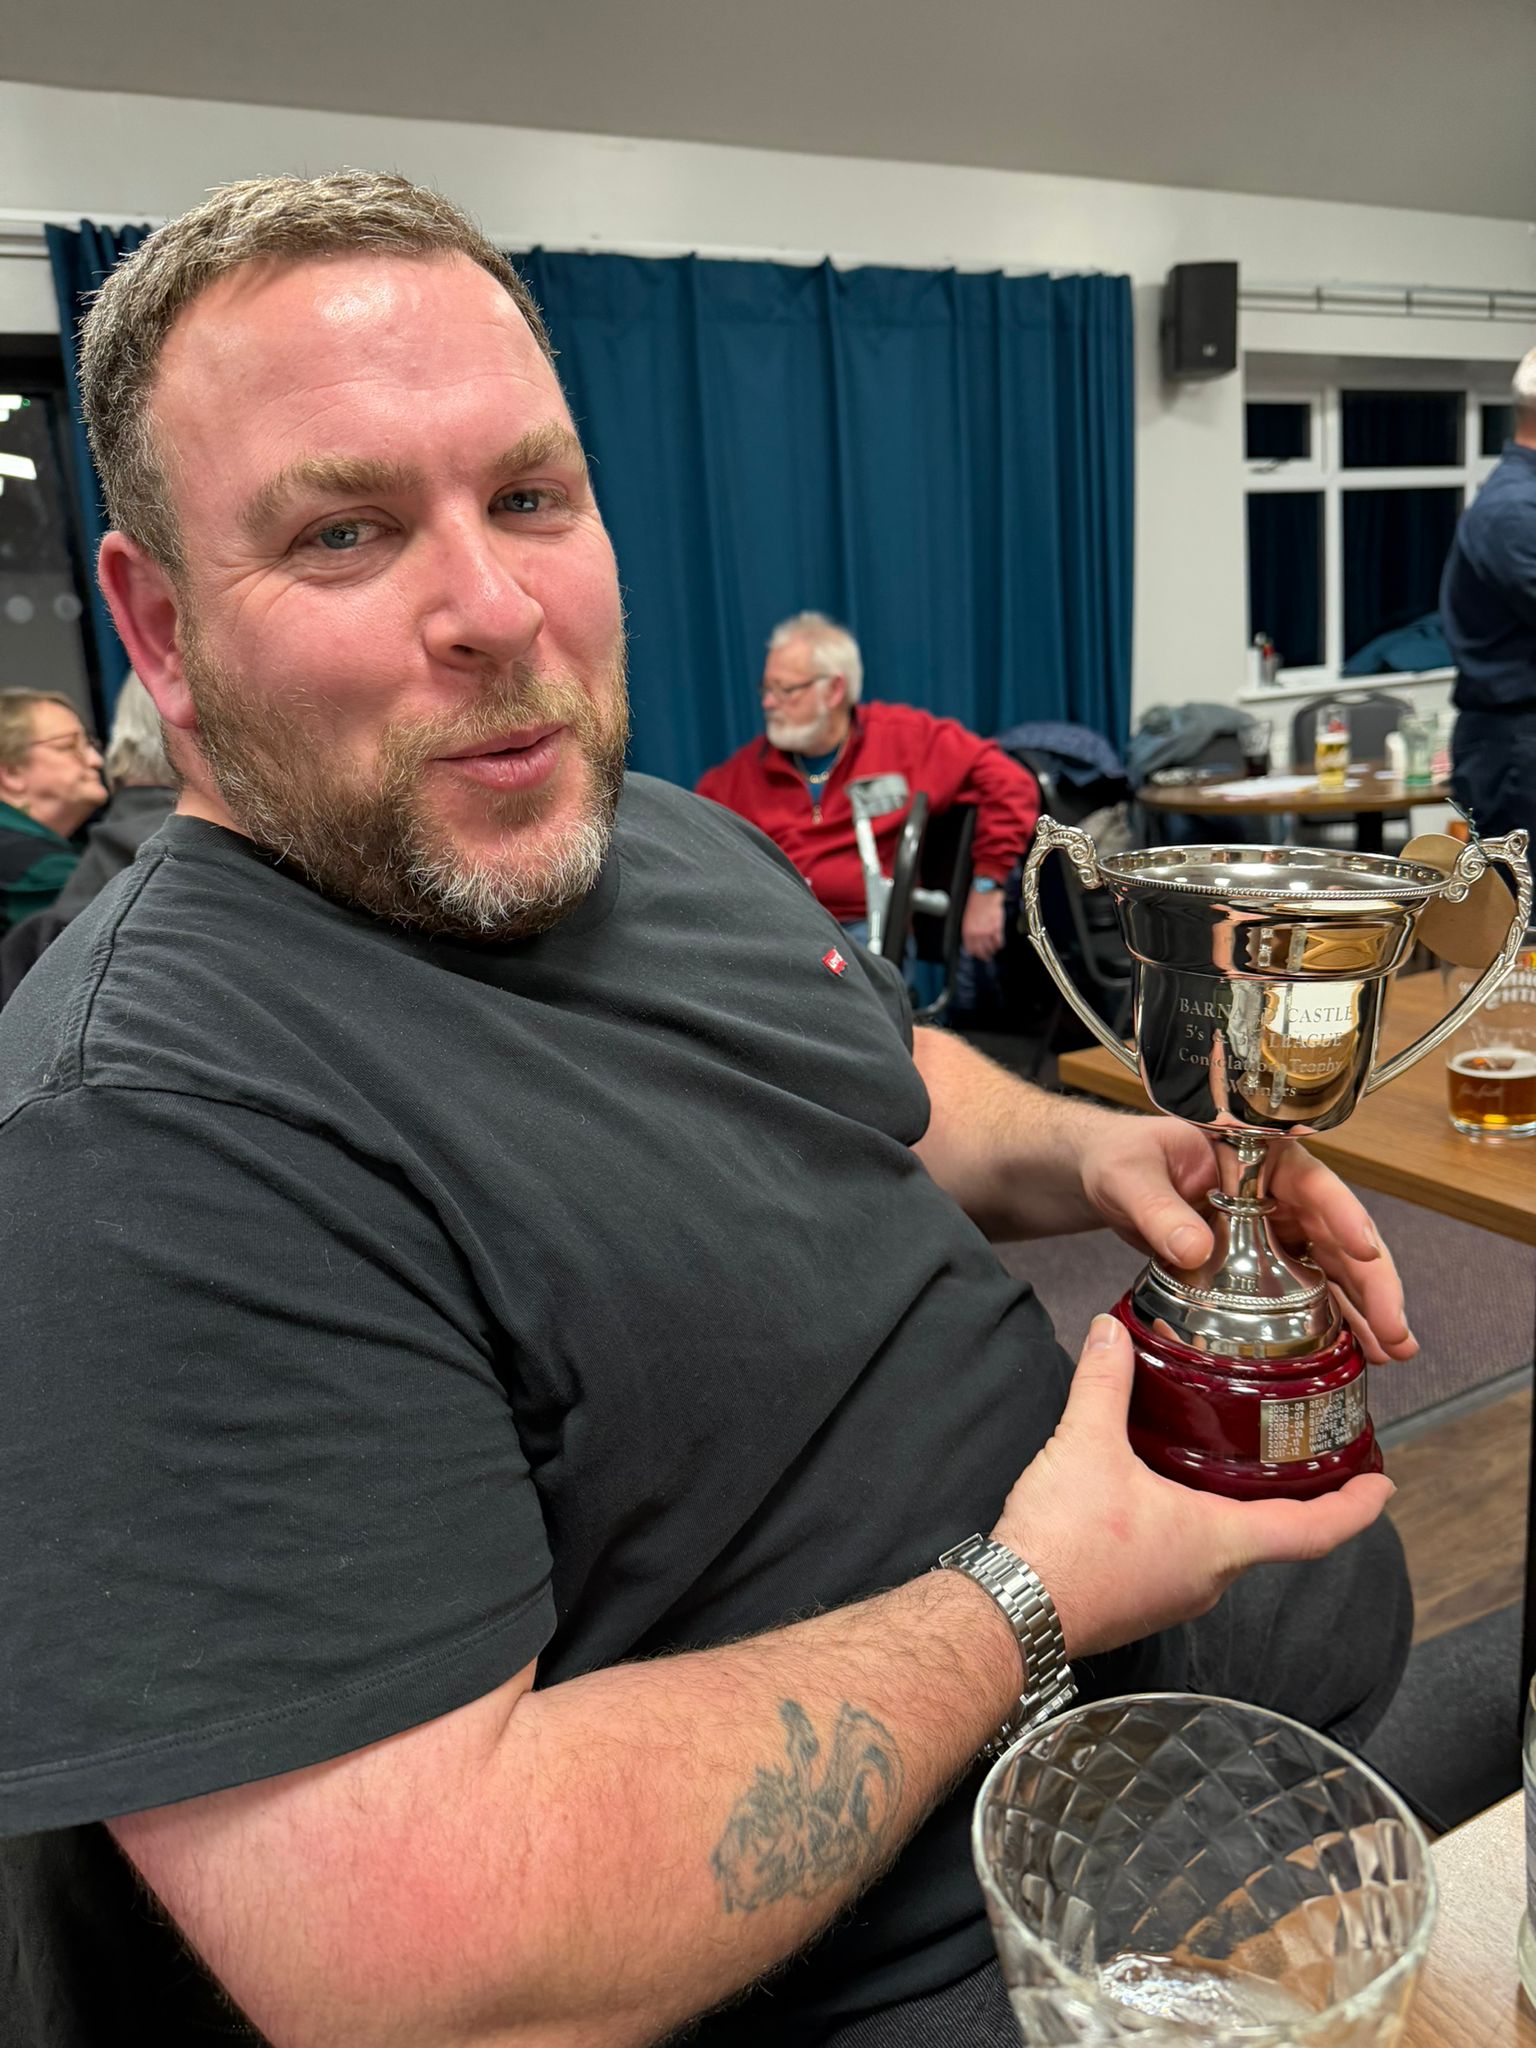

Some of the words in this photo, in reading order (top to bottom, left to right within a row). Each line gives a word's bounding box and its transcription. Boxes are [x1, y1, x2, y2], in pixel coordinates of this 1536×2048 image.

[1287, 1005, 1353, 1023] CASTLE
[1185, 1024, 1205, 1042] 5's
[1269, 1032, 1343, 1048] LEAGUE
[1179, 1048, 1281, 1073] Conolaton
[1289, 1056, 1343, 1075] Trophy
[1309, 1399, 1325, 1409] RED
